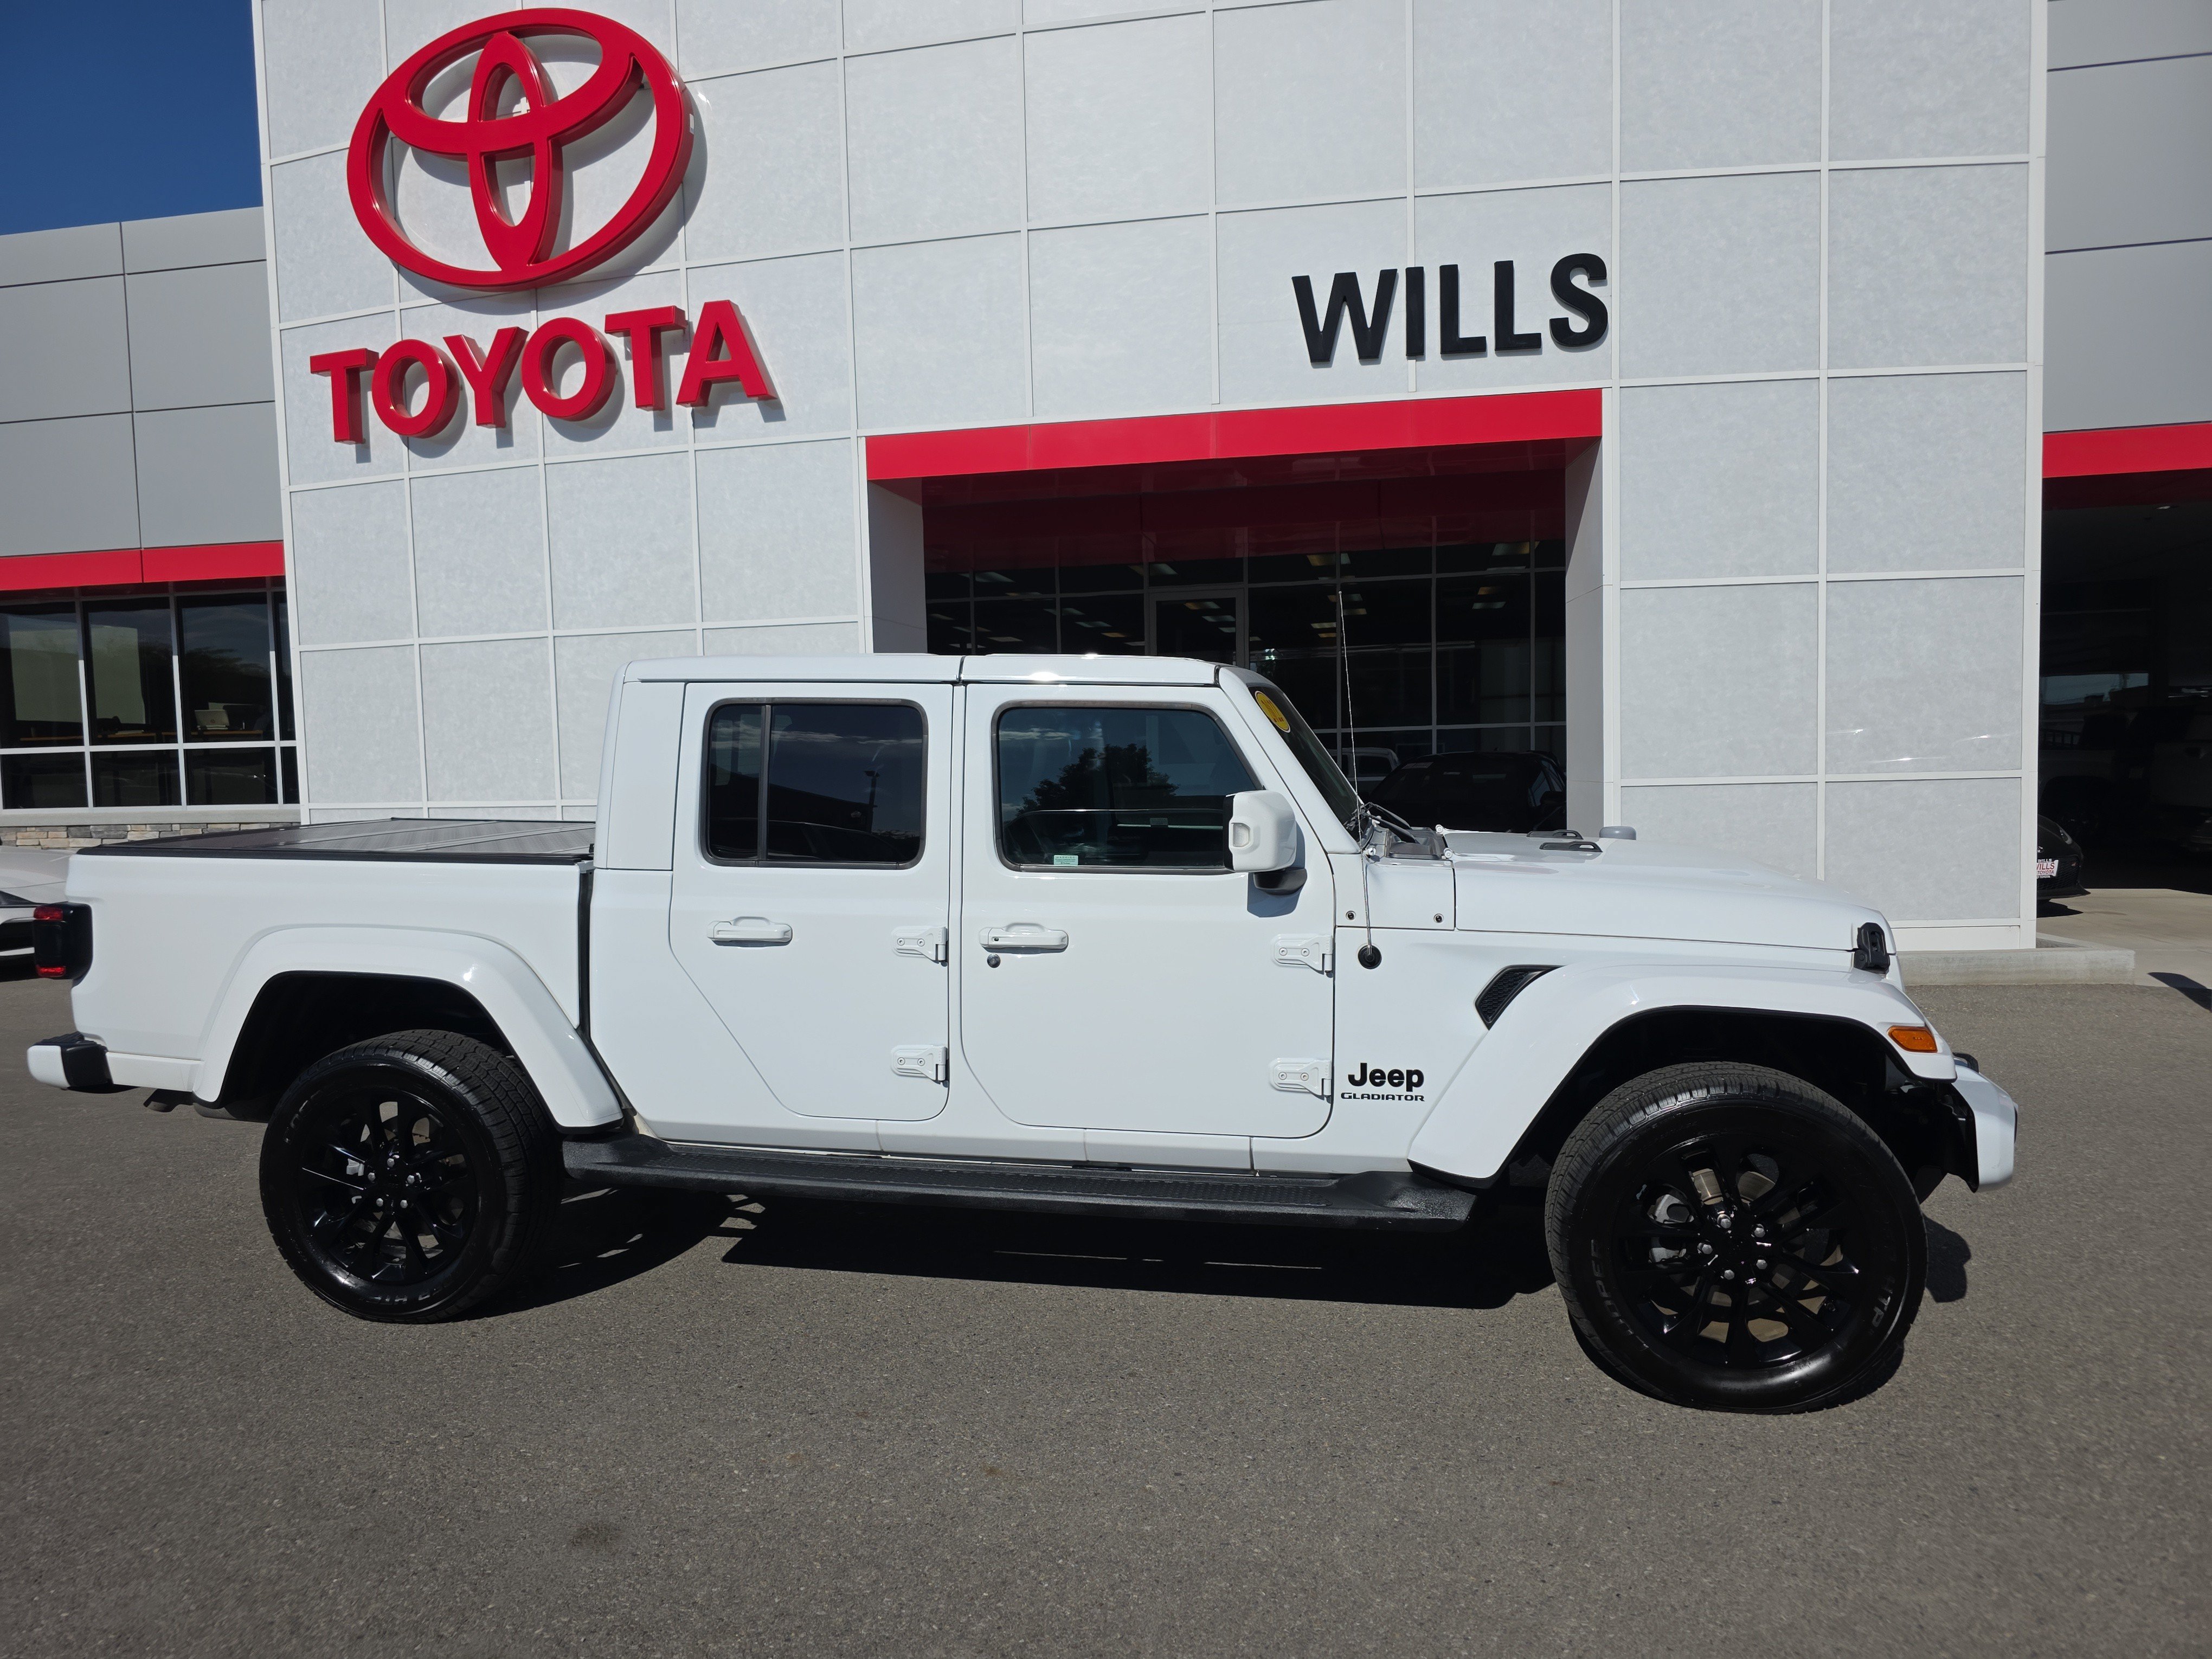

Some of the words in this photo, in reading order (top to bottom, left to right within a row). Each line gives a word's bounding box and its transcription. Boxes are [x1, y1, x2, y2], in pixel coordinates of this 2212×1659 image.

[1291, 253, 1609, 363] WILLS
[310, 300, 777, 445] TOYOTA
[1341, 1092, 1425, 1102] GLADIATOR
[1348, 1063, 1424, 1092] Jeep
